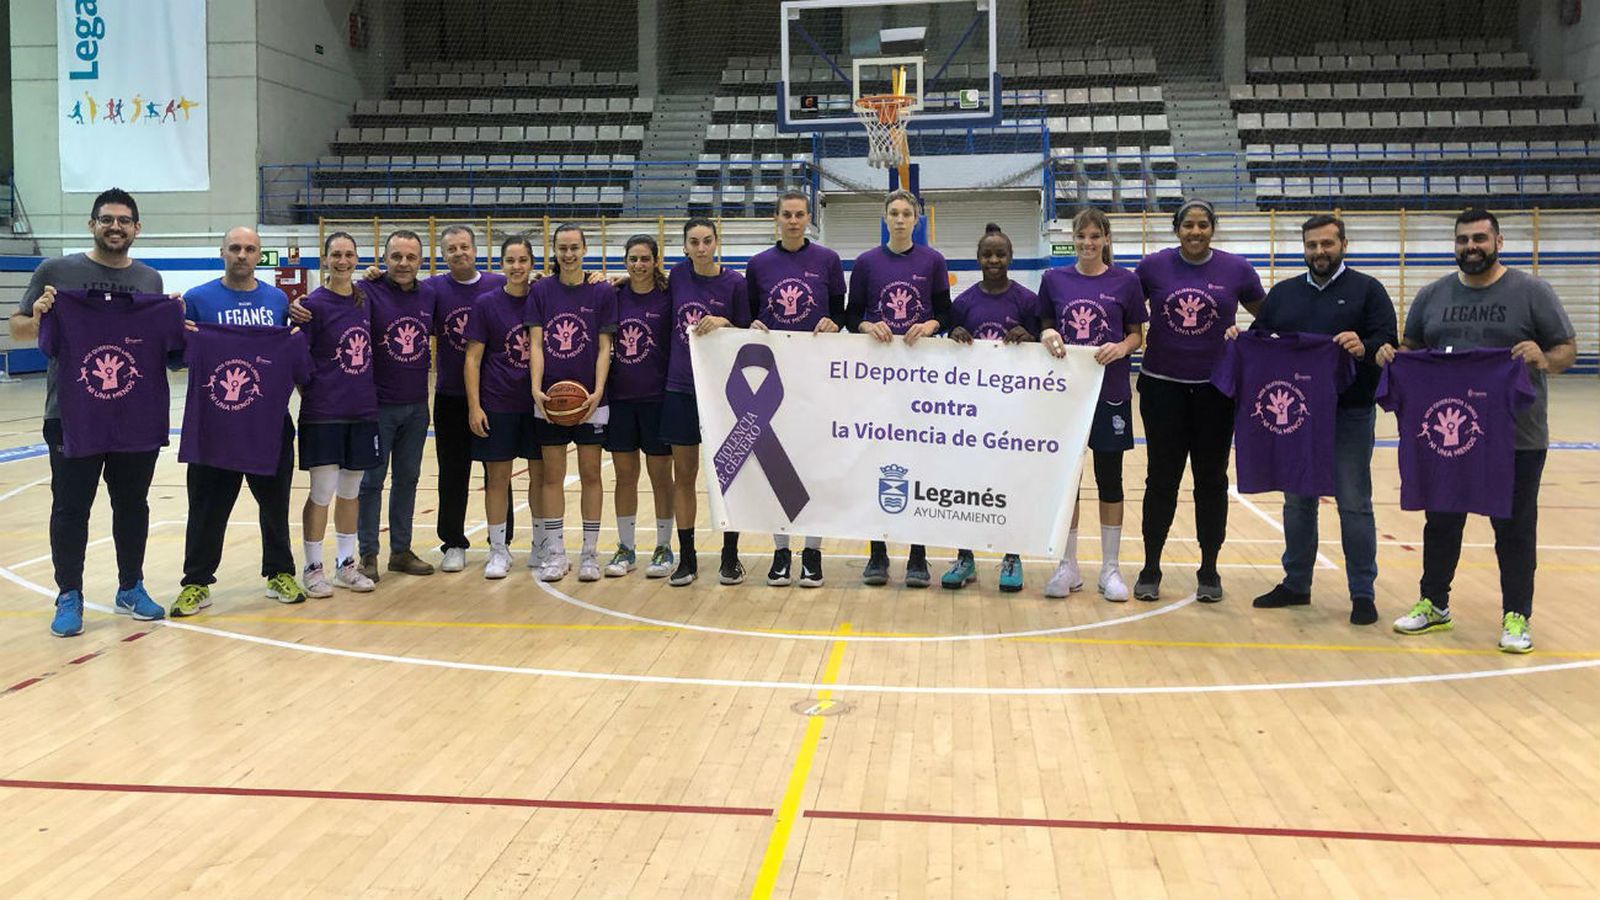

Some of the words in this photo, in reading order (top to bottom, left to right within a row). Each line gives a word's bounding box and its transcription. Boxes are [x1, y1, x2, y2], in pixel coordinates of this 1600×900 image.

[1442, 302, 1506, 322] LEGANÉS
[830, 361, 848, 379] El
[855, 362, 938, 384] Deporte
[944, 366, 970, 386] de
[978, 368, 1067, 394] Leganés
[94, 391, 110, 399] UNA
[911, 400, 977, 418] contra
[716, 412, 758, 464] VIOLENCIA
[832, 421, 848, 438] la
[854, 422, 946, 445] Violencia
[952, 429, 976, 447] de
[982, 430, 1059, 453] Género
[1437, 448, 1452, 457] UNA
[914, 480, 1007, 508] Leganés
[914, 507, 1007, 526] AYUNTAMIENTO
